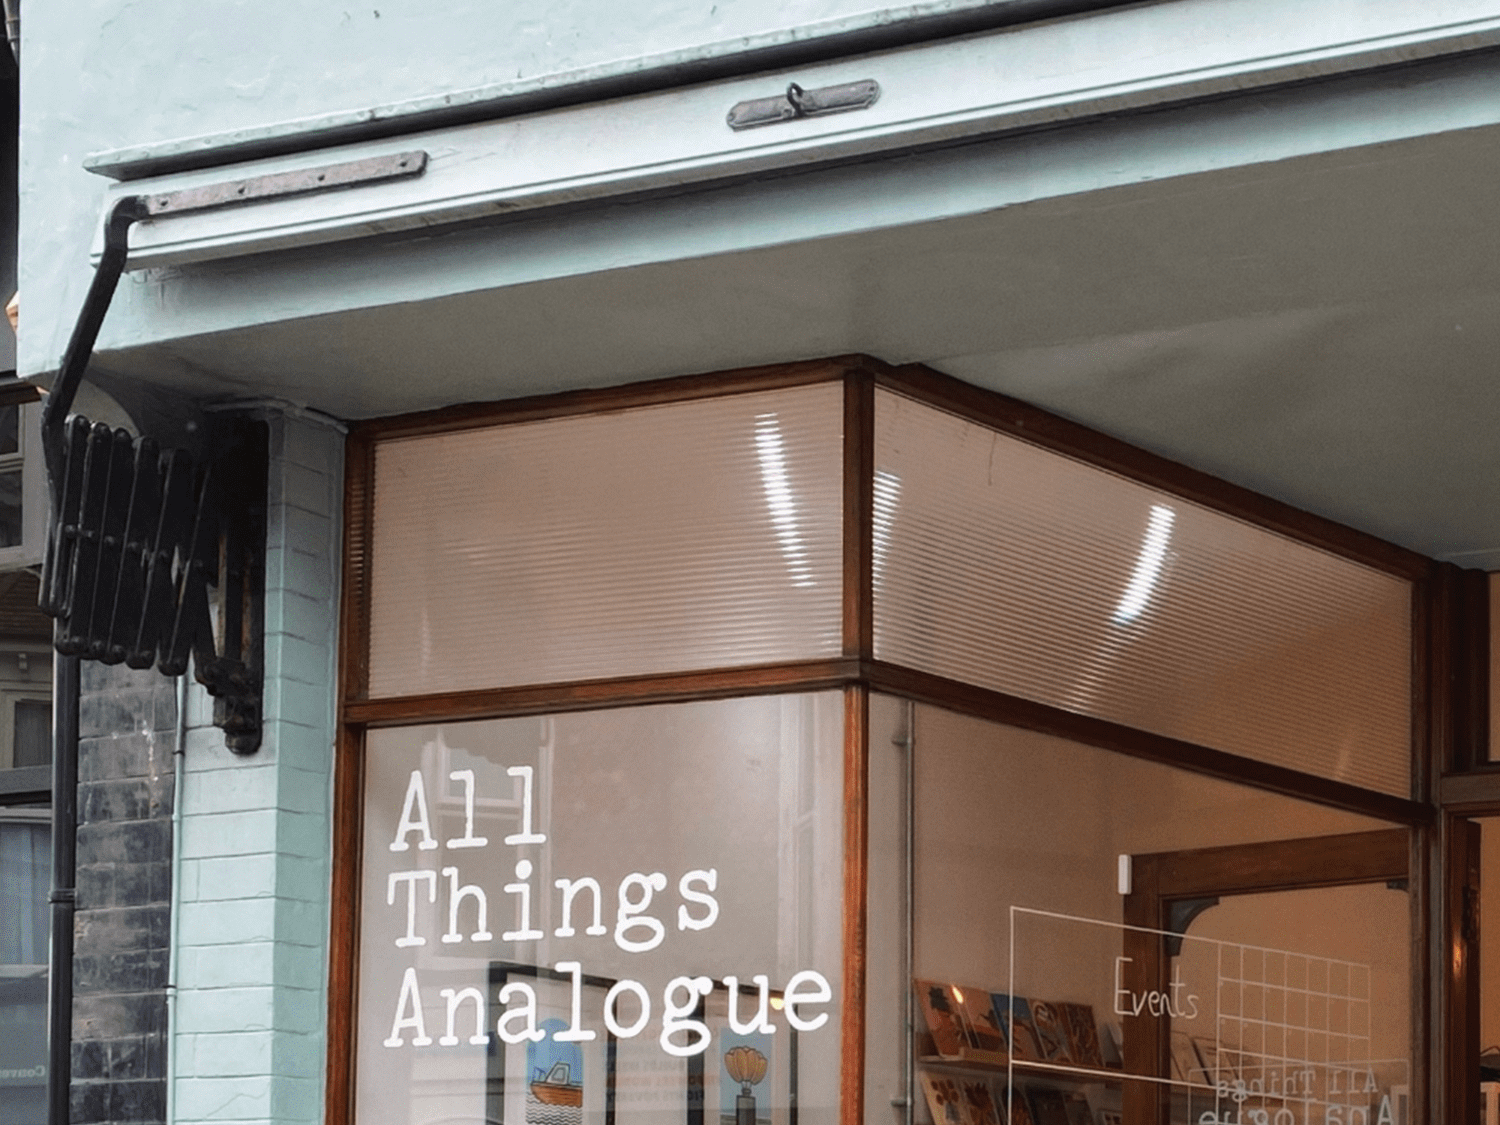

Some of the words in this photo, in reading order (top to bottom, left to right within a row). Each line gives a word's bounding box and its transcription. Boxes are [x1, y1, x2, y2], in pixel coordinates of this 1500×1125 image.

[388, 766, 547, 852] All
[386, 860, 719, 952] Things
[384, 961, 833, 1057] Analogue
[1114, 957, 1199, 1019] Events
